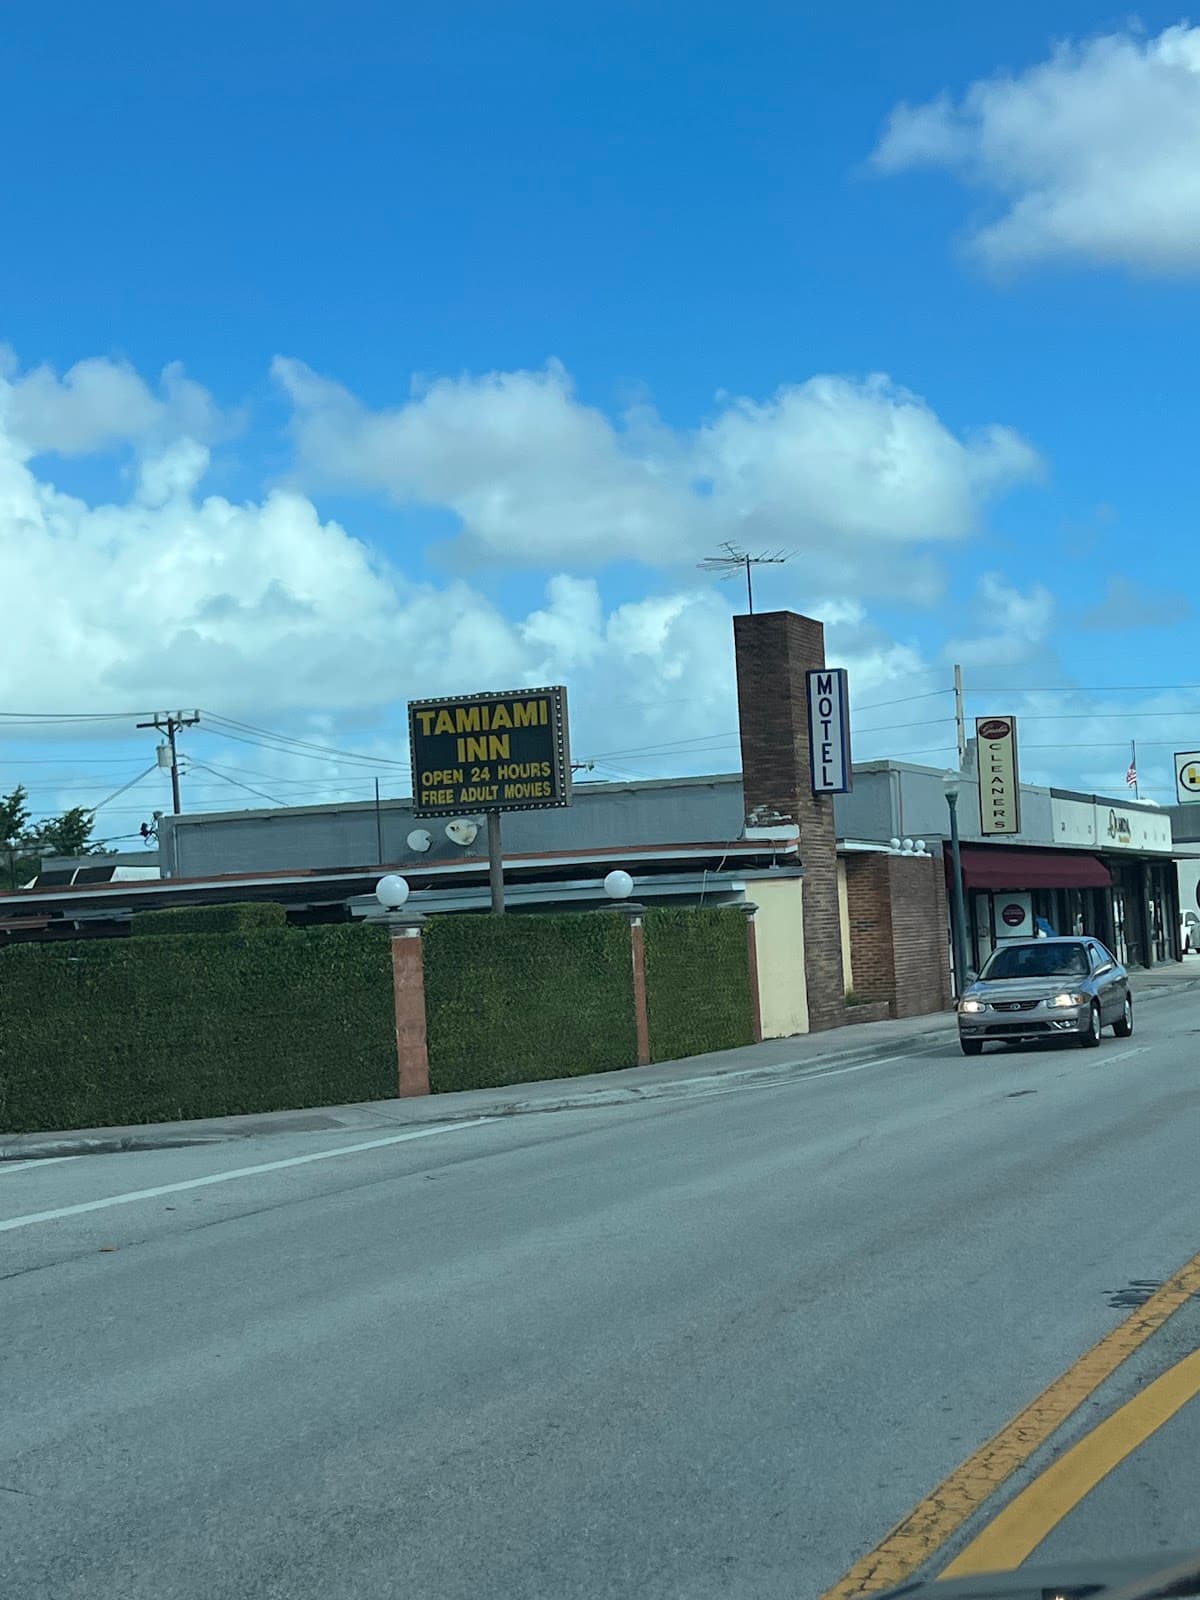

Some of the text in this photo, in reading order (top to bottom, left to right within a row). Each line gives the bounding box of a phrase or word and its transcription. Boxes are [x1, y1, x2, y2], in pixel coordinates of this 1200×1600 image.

[416, 701, 548, 736] TAMIAMI
[817, 674, 834, 786] MOTEL
[457, 734, 510, 763] INN
[422, 762, 551, 786] OPEN 24 HOURS
[989, 743, 1006, 828] CLEANERS
[422, 781, 551, 805] FREE ADULT MOVIES
